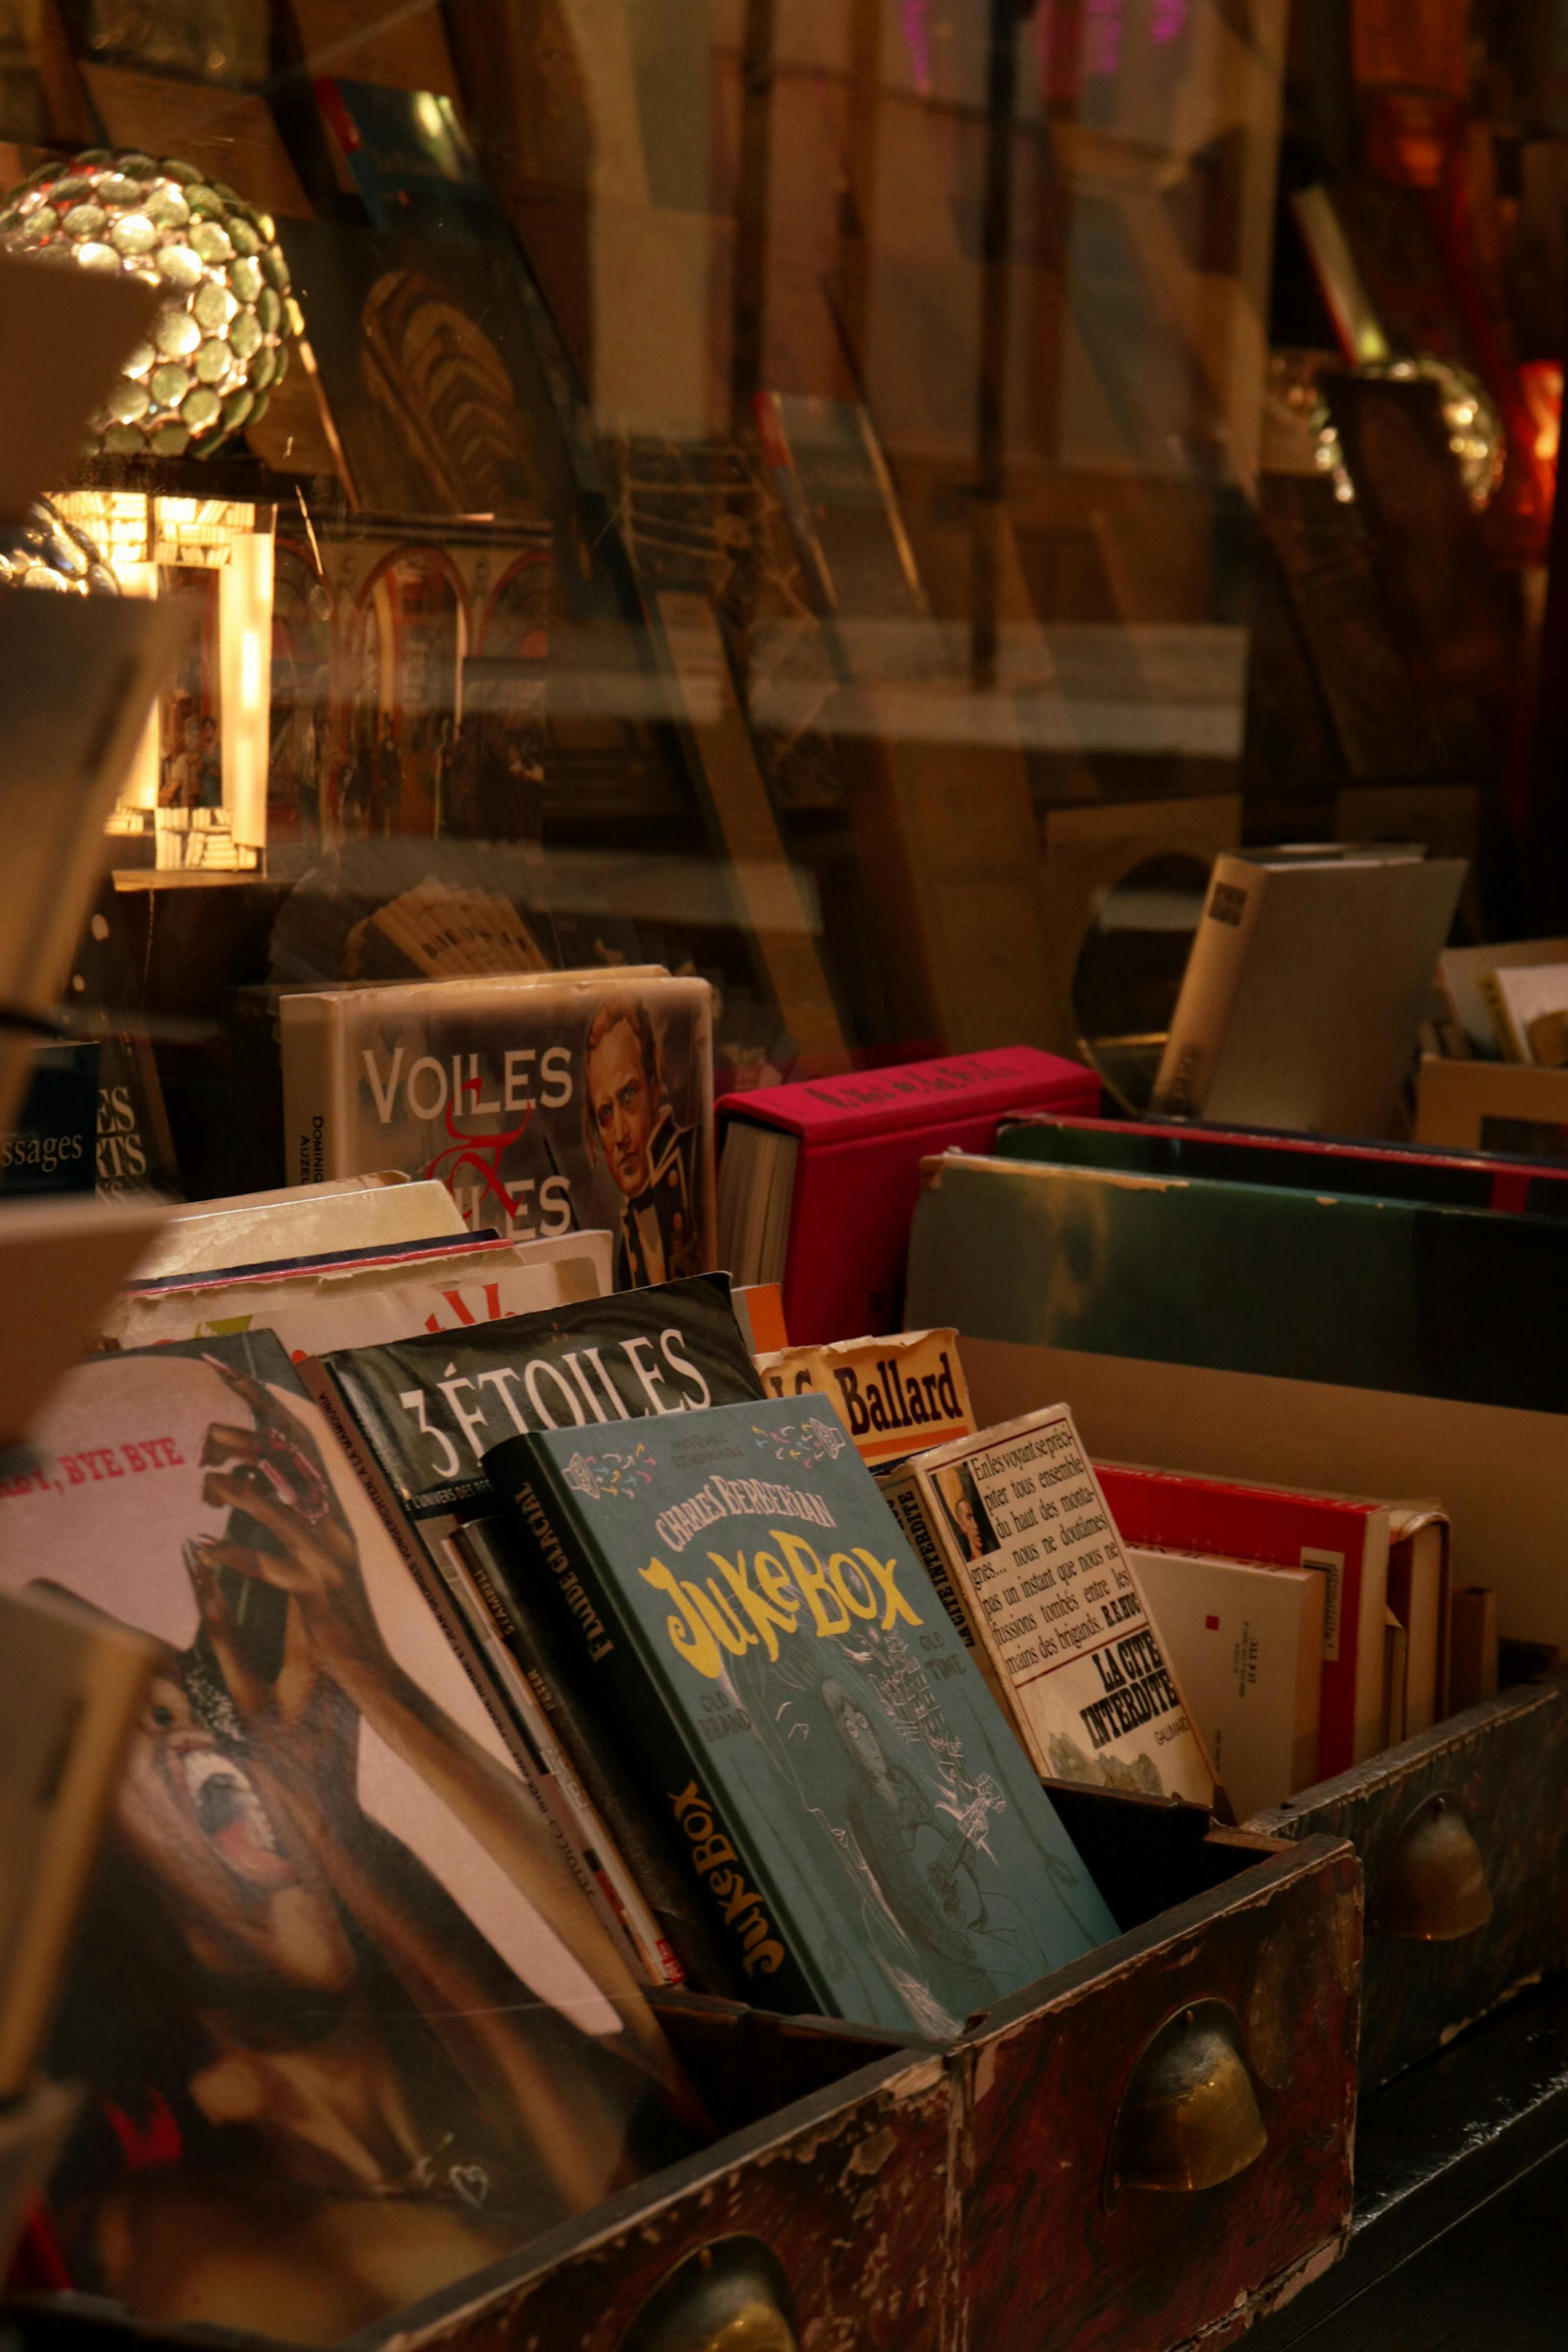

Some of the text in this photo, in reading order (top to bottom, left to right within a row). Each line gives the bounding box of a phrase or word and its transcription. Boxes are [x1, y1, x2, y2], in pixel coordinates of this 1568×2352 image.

[362, 1046, 573, 1124] VOILES
[318, 1391, 353, 1450] MAMOUNIA
[834, 1352, 964, 1436] Ballard
[57, 1448, 125, 1486] BYE
[121, 1438, 185, 1474] BYE
[349, 1450, 363, 1468] LA
[984, 1486, 1009, 1516] piter
[1011, 1476, 1037, 1500] tous
[1038, 1454, 1084, 1489] ensemble
[1003, 1441, 1038, 1471] voyant
[655, 1483, 723, 1552] CHARLES
[898, 1490, 950, 1587] INTERDITE
[995, 1513, 1012, 1539] du
[1009, 1508, 1038, 1534] haut
[1039, 1498, 1059, 1522] des
[514, 1481, 614, 1663] FLUIDE GLACIAL
[982, 1597, 1003, 1622] pas
[1002, 1586, 1021, 1606] un
[1017, 1566, 1057, 1599] instant
[1057, 1560, 1078, 1586] que
[1078, 1547, 1104, 1573] nous
[1104, 1541, 1119, 1561] ne
[1012, 1542, 1040, 1568] nous
[1042, 1535, 1058, 1555] ne
[1040, 1589, 1079, 1623] tombés
[1082, 1579, 1111, 1604] entre
[1111, 1567, 1131, 1590] les
[1006, 1645, 1039, 1676] mains
[1038, 1635, 1058, 1660] des
[1092, 1628, 1164, 1693] LA CITE
[1079, 1668, 1181, 1750] INTERDITE
